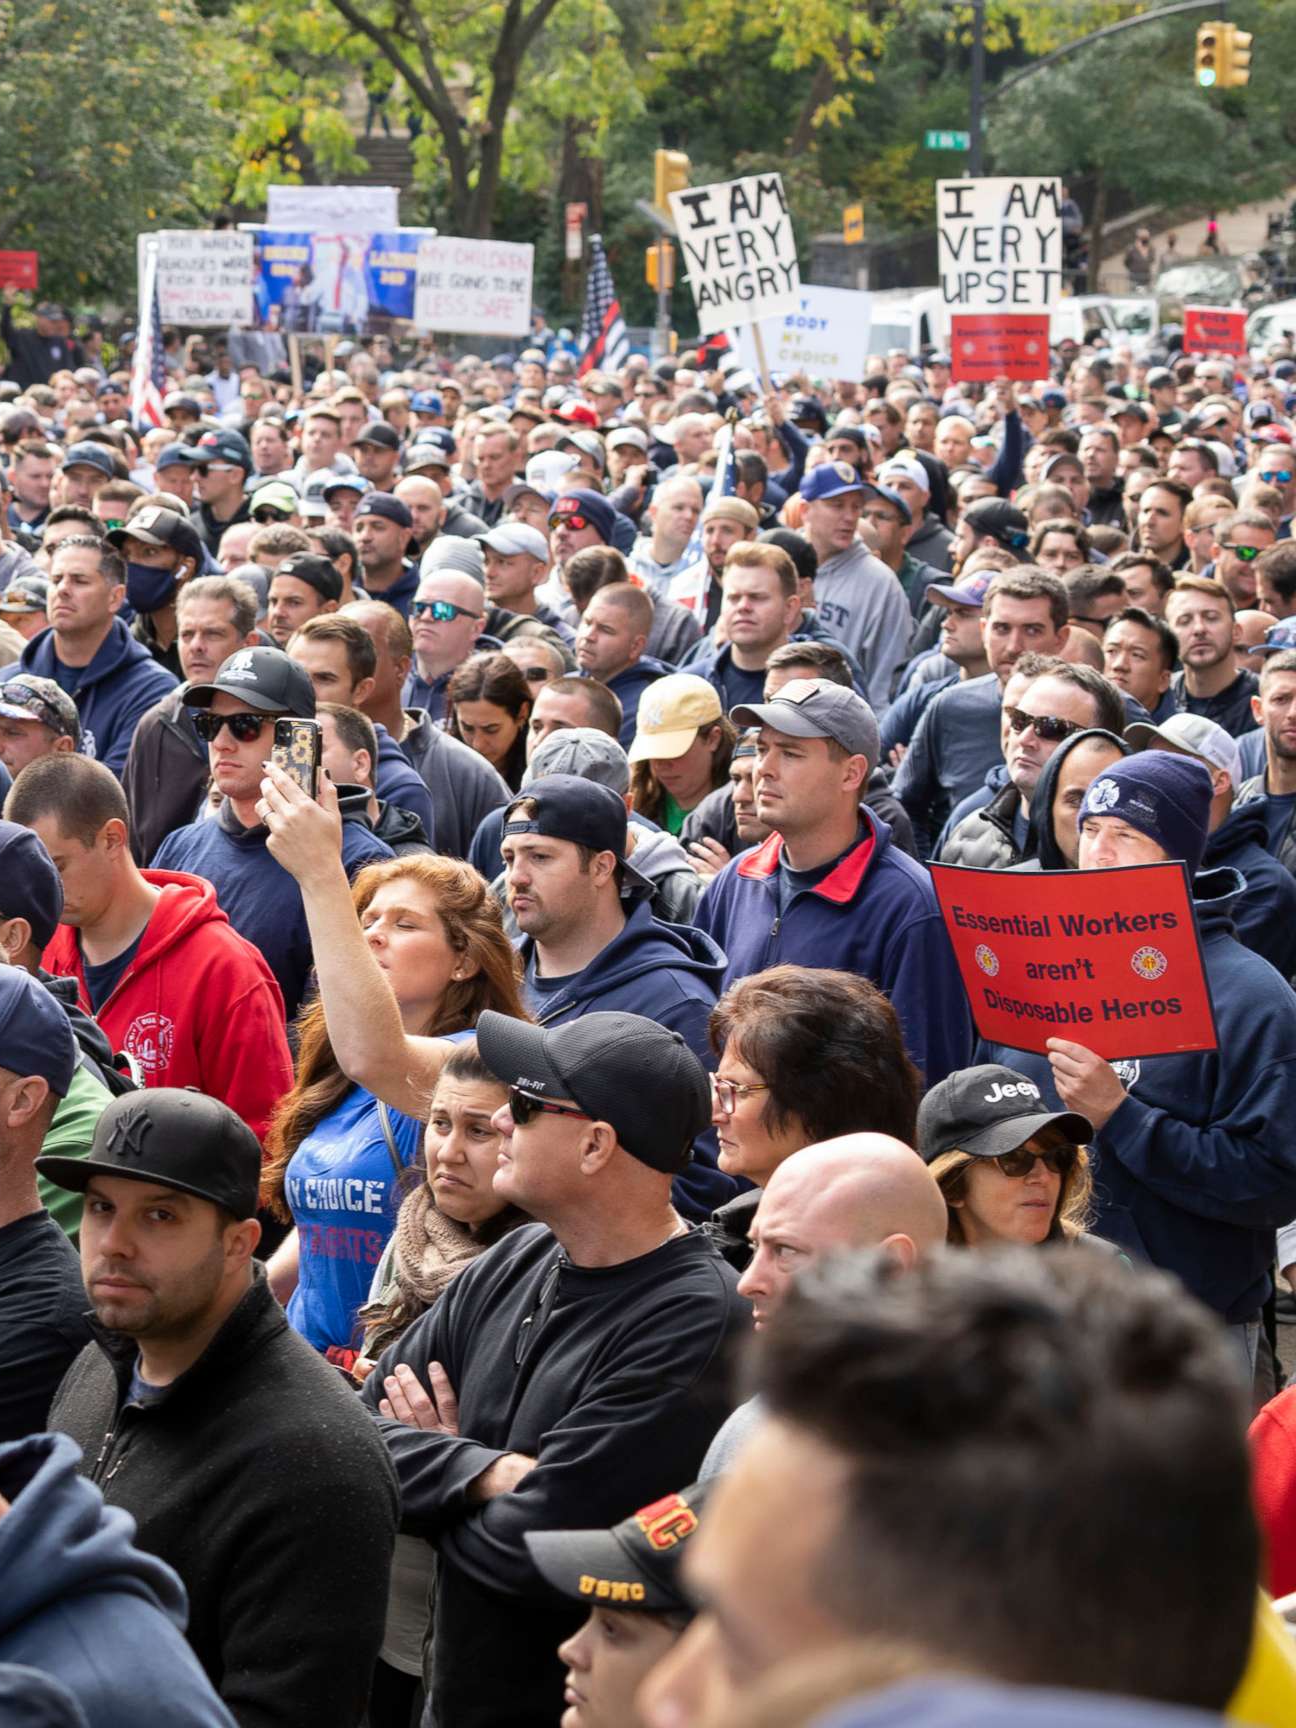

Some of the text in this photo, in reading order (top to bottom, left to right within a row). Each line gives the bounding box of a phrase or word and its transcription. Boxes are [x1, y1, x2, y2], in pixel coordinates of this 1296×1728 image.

[680, 178, 788, 230] I AM
[944, 182, 1062, 219] I AM
[684, 221, 782, 272] VERY
[939, 226, 1057, 264] VERY
[697, 261, 798, 310] ANGRY
[942, 270, 1060, 305] UPSET
[784, 315, 830, 331] BODY
[952, 906, 1178, 937] Essential Workers
[1026, 959, 1095, 980] aren't
[983, 988, 1182, 1024] Disposable Heros
[984, 1081, 1040, 1104] Jeep
[106, 1107, 153, 1156] NY
[305, 1178, 384, 1213] CHOICE
[578, 1574, 646, 1602] USMC
